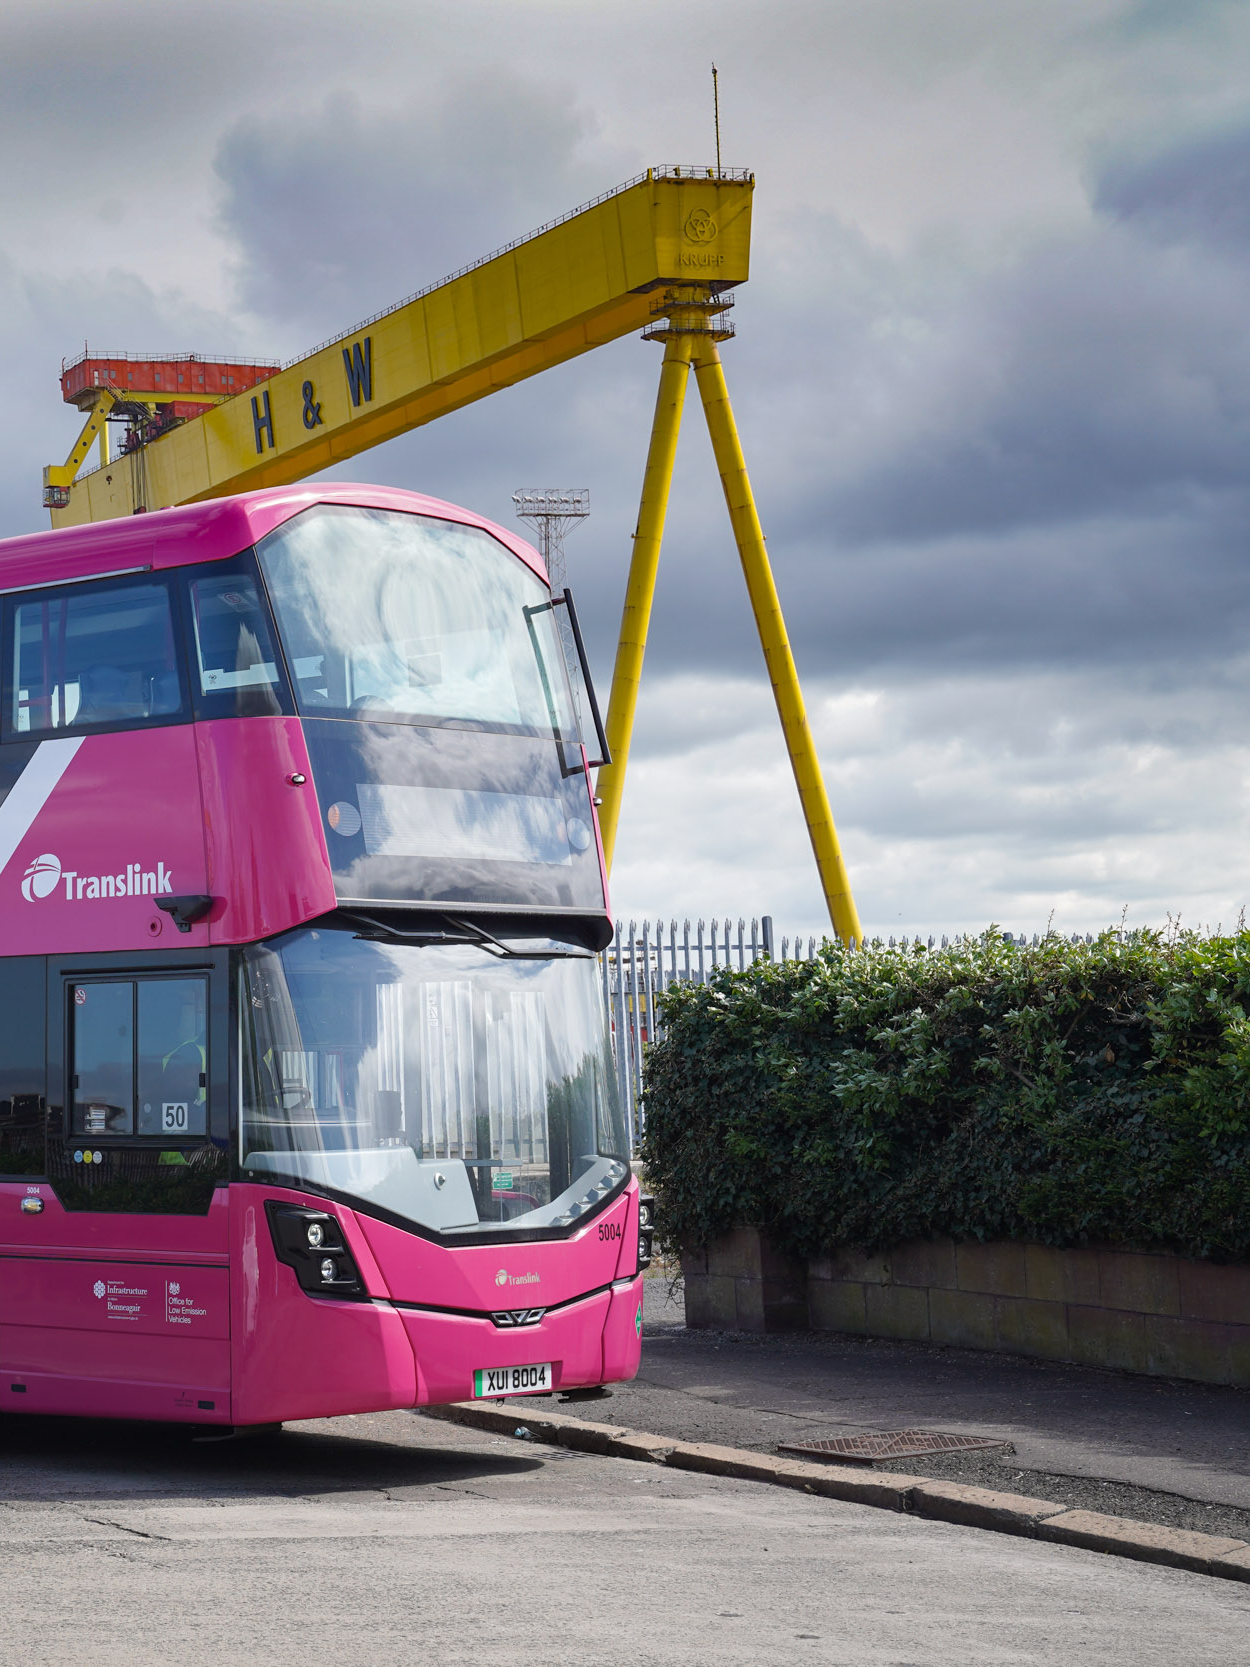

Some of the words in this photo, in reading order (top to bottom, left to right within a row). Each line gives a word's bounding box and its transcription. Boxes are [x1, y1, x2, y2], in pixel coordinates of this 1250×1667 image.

[678, 253, 726, 267] KRUPP
[250, 389, 275, 454] H
[301, 380, 324, 430] &
[341, 336, 372, 408] W
[61, 861, 173, 901] Translink
[165, 1105, 186, 1128] 50
[598, 1223, 622, 1241] 5004
[508, 1271, 541, 1286] Translink
[107, 1285, 148, 1296] Infrastructure
[168, 1297, 185, 1305] Office
[185, 1298, 194, 1306] for
[168, 1306, 180, 1314] Low
[181, 1307, 206, 1316] Emission
[168, 1315, 192, 1324] Vehicles
[487, 1369, 509, 1392] XUI
[512, 1366, 546, 1389] 8004
